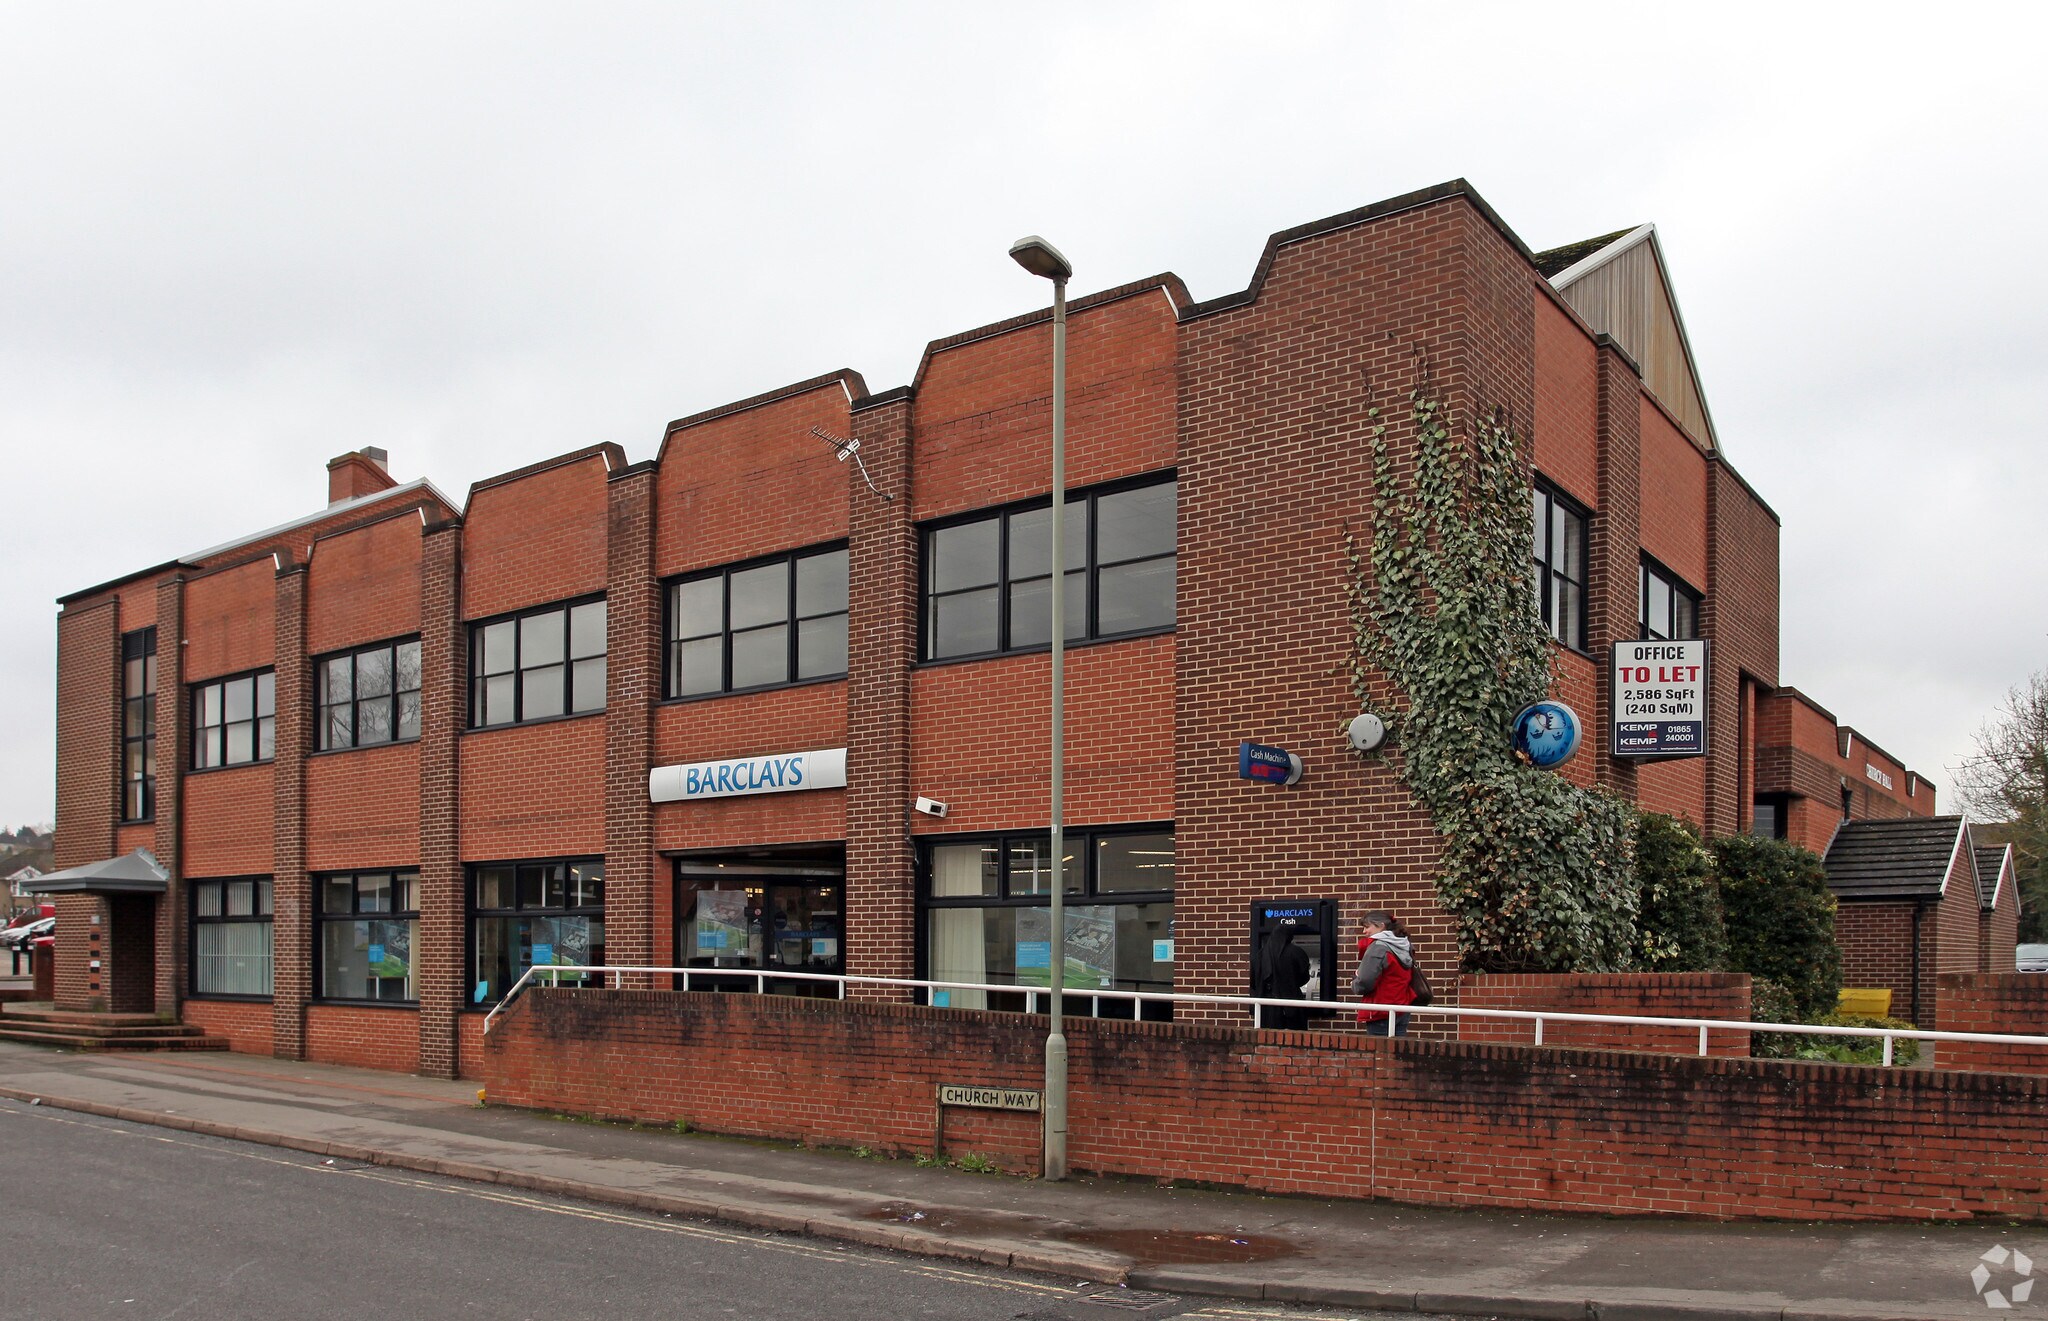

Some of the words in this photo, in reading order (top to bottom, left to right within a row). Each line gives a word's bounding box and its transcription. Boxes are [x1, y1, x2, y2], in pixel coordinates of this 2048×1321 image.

[1634, 647, 1685, 660] OFFICE
[1619, 667, 1651, 683] TO
[1659, 666, 1701, 682] LET
[1624, 690, 1662, 701] 2,586
[1665, 689, 1695, 701] SqFt
[1625, 704, 1656, 716] (240
[1660, 703, 1693, 715] SqM)
[1668, 725, 1691, 733] 01865
[1665, 734, 1694, 742] 240001
[1250, 749, 1264, 760] Cash
[1264, 751, 1286, 763] Machine
[686, 757, 803, 795] BARCLAYS
[1273, 908, 1313, 918] BARCLAYS
[946, 1089, 999, 1105] CHURCH
[1004, 1093, 1035, 1107] WAY
